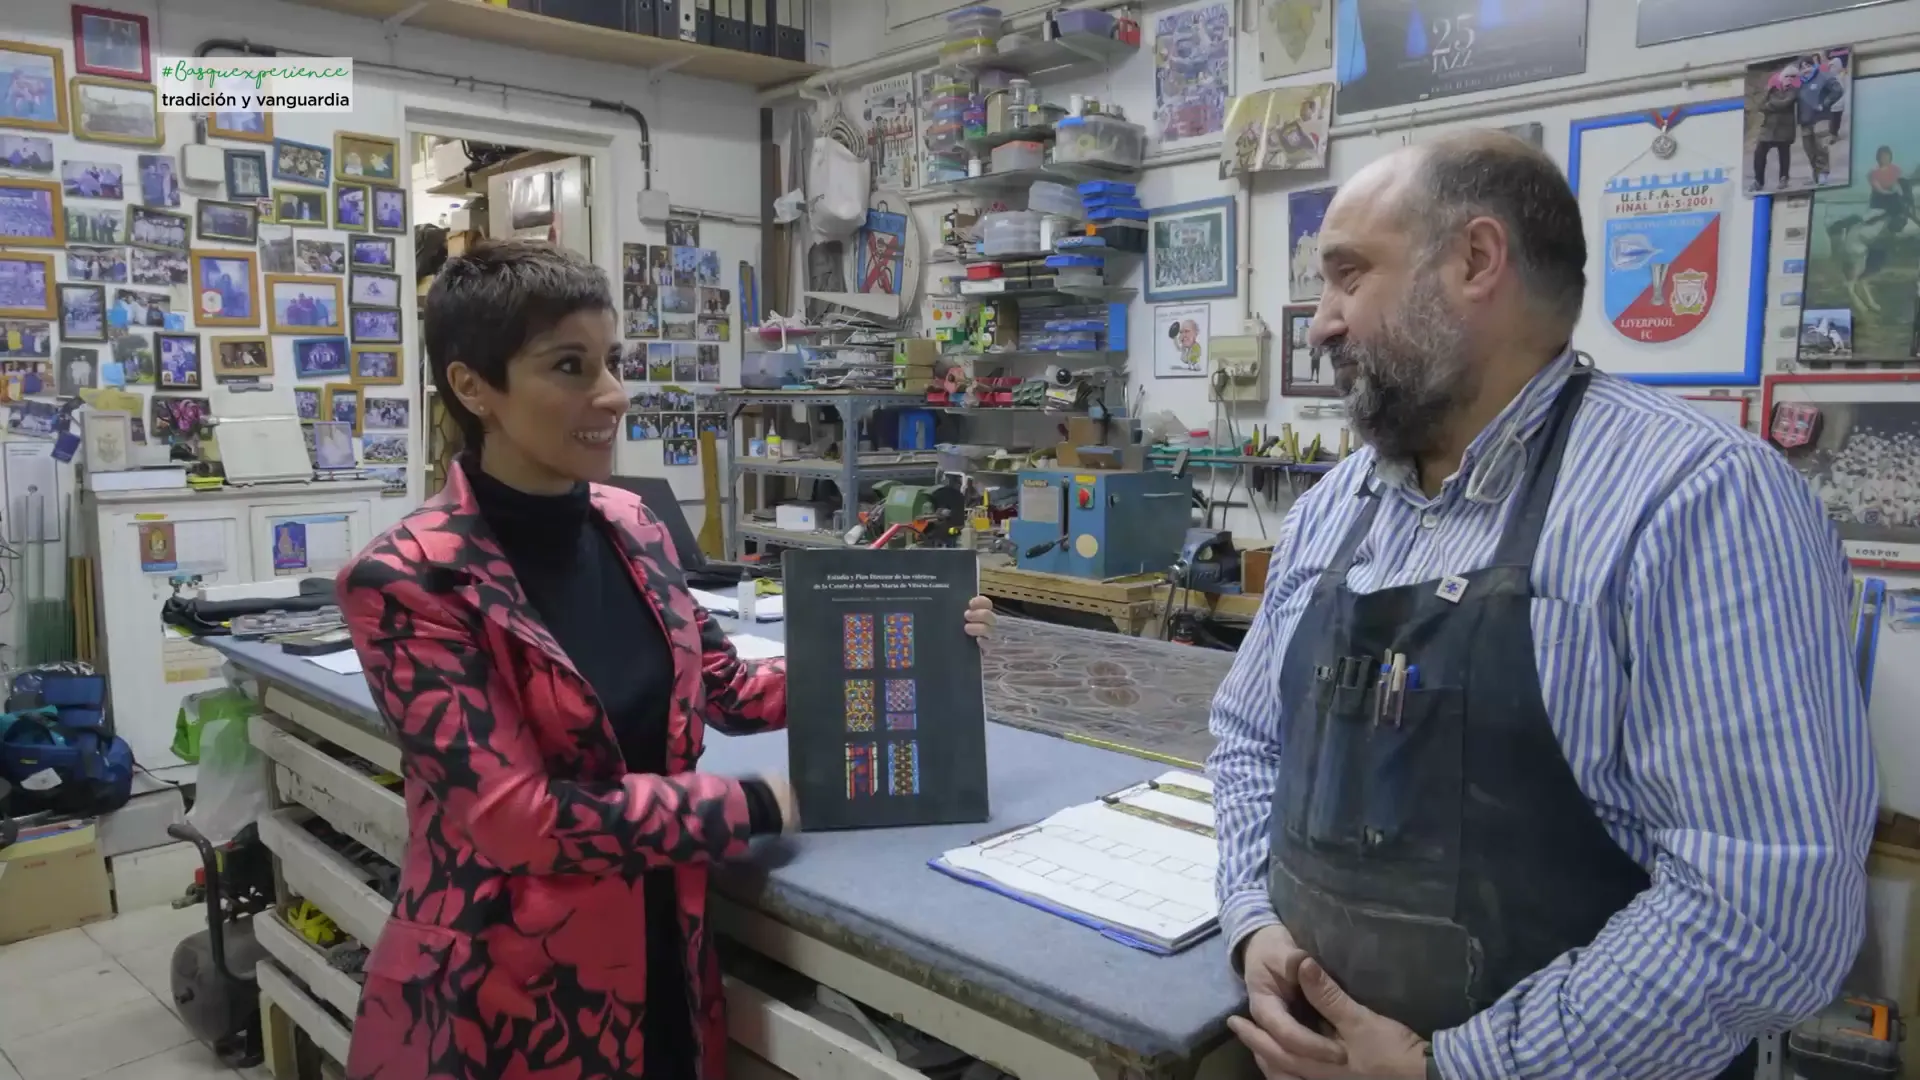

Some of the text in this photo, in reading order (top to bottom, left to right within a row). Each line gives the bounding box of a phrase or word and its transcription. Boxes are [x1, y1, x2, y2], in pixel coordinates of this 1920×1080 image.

[1431, 14, 1475, 57] 25
[1681, 185, 1710, 197] CUP
[1615, 202, 1648, 214] FINAL
[1620, 317, 1676, 329] LIVERPOOL
[1640, 329, 1653, 340] FC
